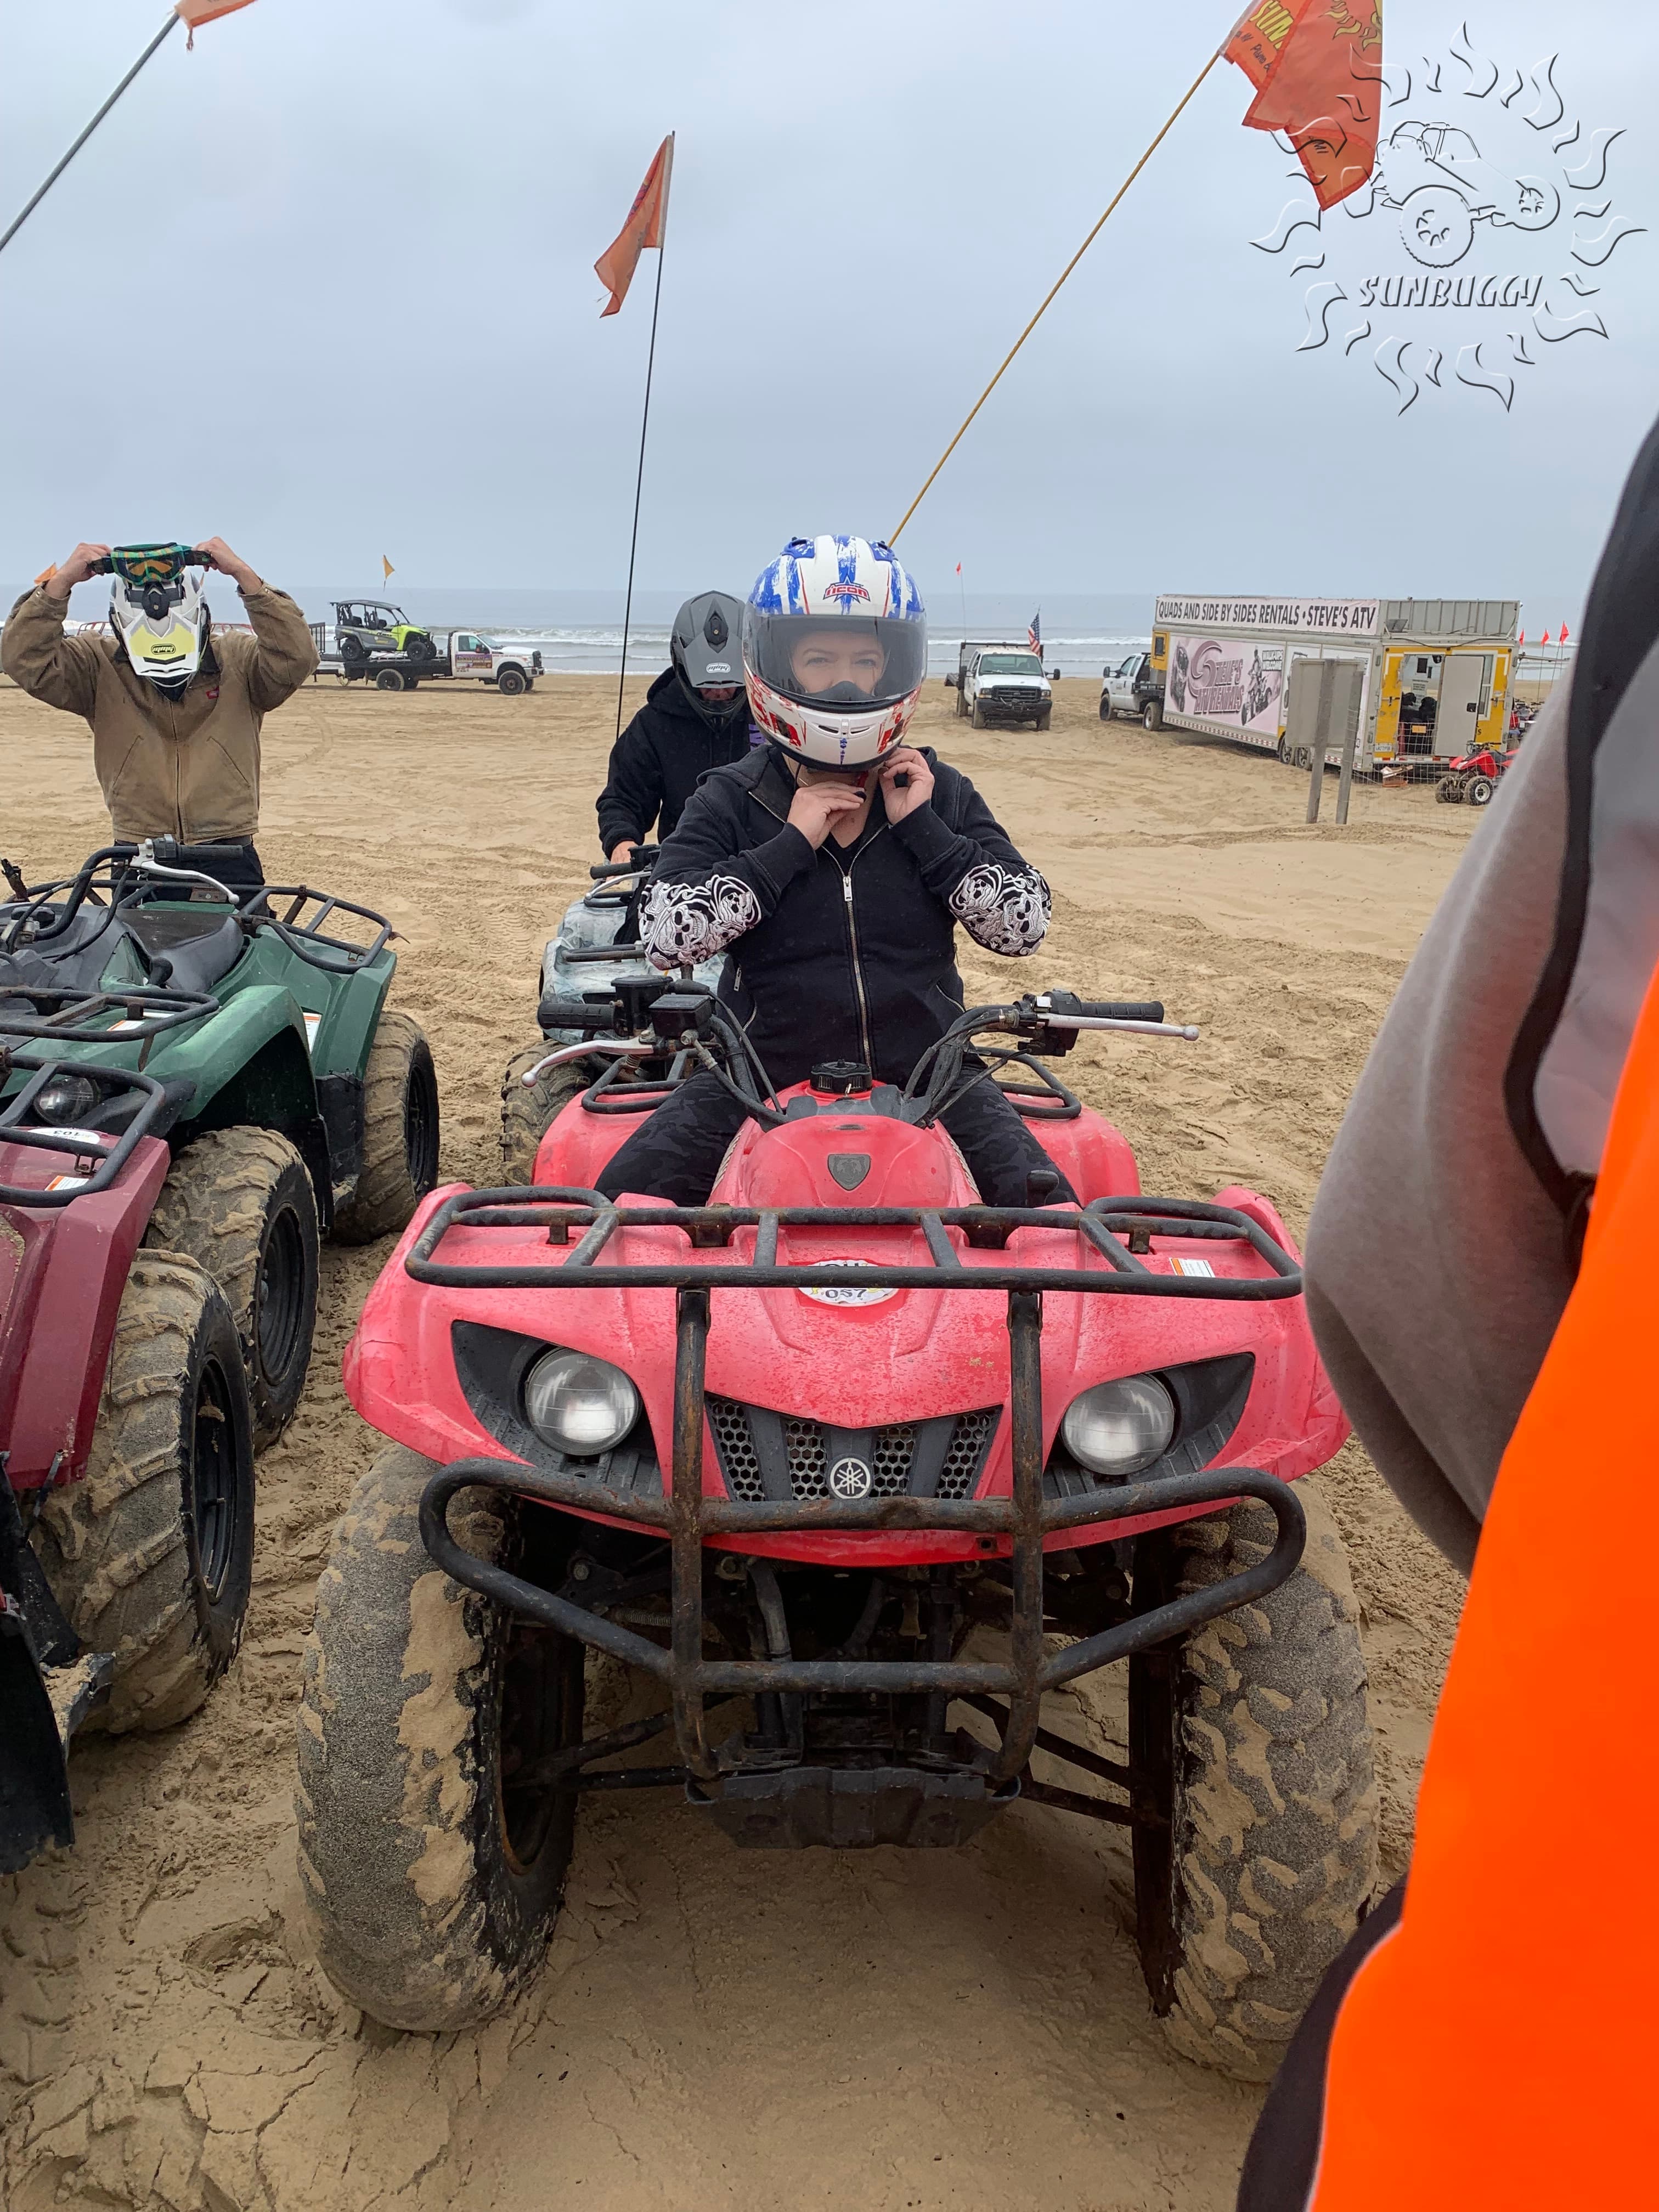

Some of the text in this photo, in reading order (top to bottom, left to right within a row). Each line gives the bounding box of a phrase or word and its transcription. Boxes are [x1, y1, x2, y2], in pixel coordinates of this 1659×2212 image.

[1249, 0, 1294, 50] SUN
[1159, 601, 1376, 629] QUADS AND SIDE BY SIDES RENTALS STEVE'S ATV
[825, 1289, 867, 1299] 057
